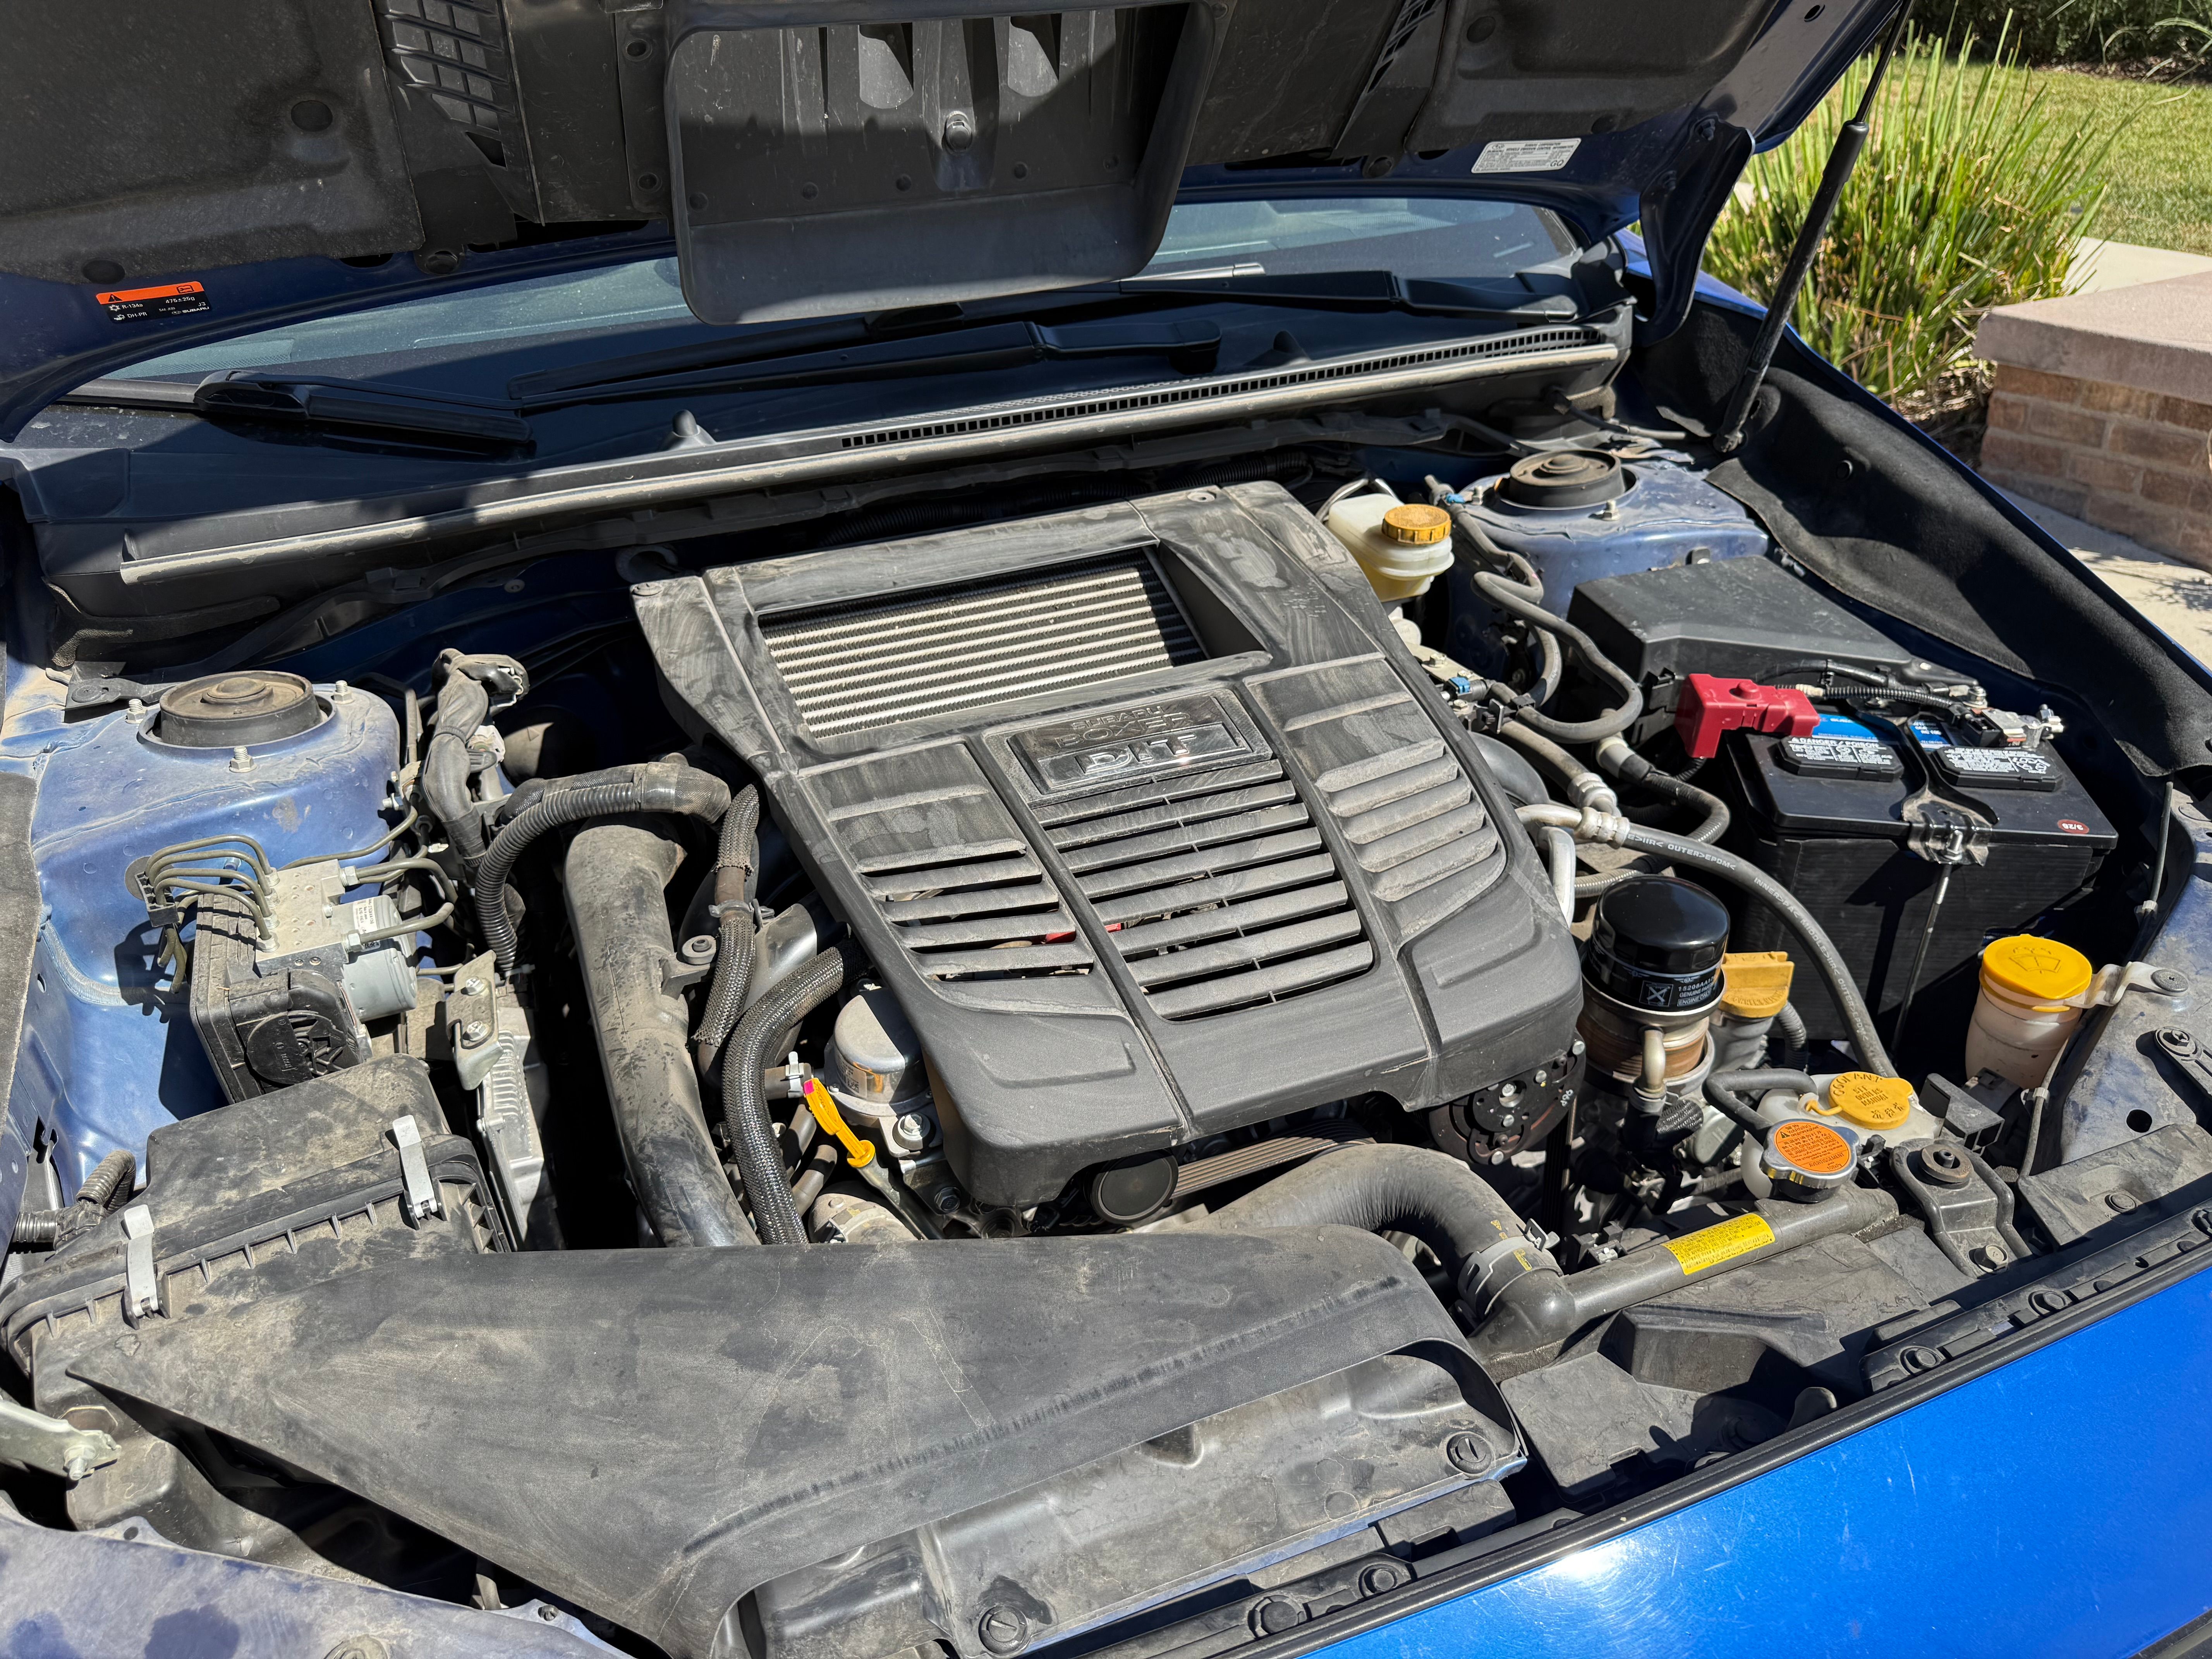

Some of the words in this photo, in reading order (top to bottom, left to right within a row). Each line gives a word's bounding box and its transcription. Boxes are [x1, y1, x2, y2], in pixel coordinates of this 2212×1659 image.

[1072, 706, 1164, 730] SUBARU
[1054, 712, 1194, 749] BOXER
[1074, 734, 1197, 774] DIT
[1668, 844, 1736, 871] OUTER>EPDM<
[1754, 877, 1799, 918] INNER>PA<
[1678, 975, 1717, 991] 15208AA17
[1679, 988, 1701, 998] GENUINE
[1833, 1073, 1883, 1097] COOLANT
[1861, 1093, 1889, 1106] MANUAL
[1787, 1124, 1811, 1134] WARNING
[1809, 1152, 1844, 1167] AVERTISSEMENT
